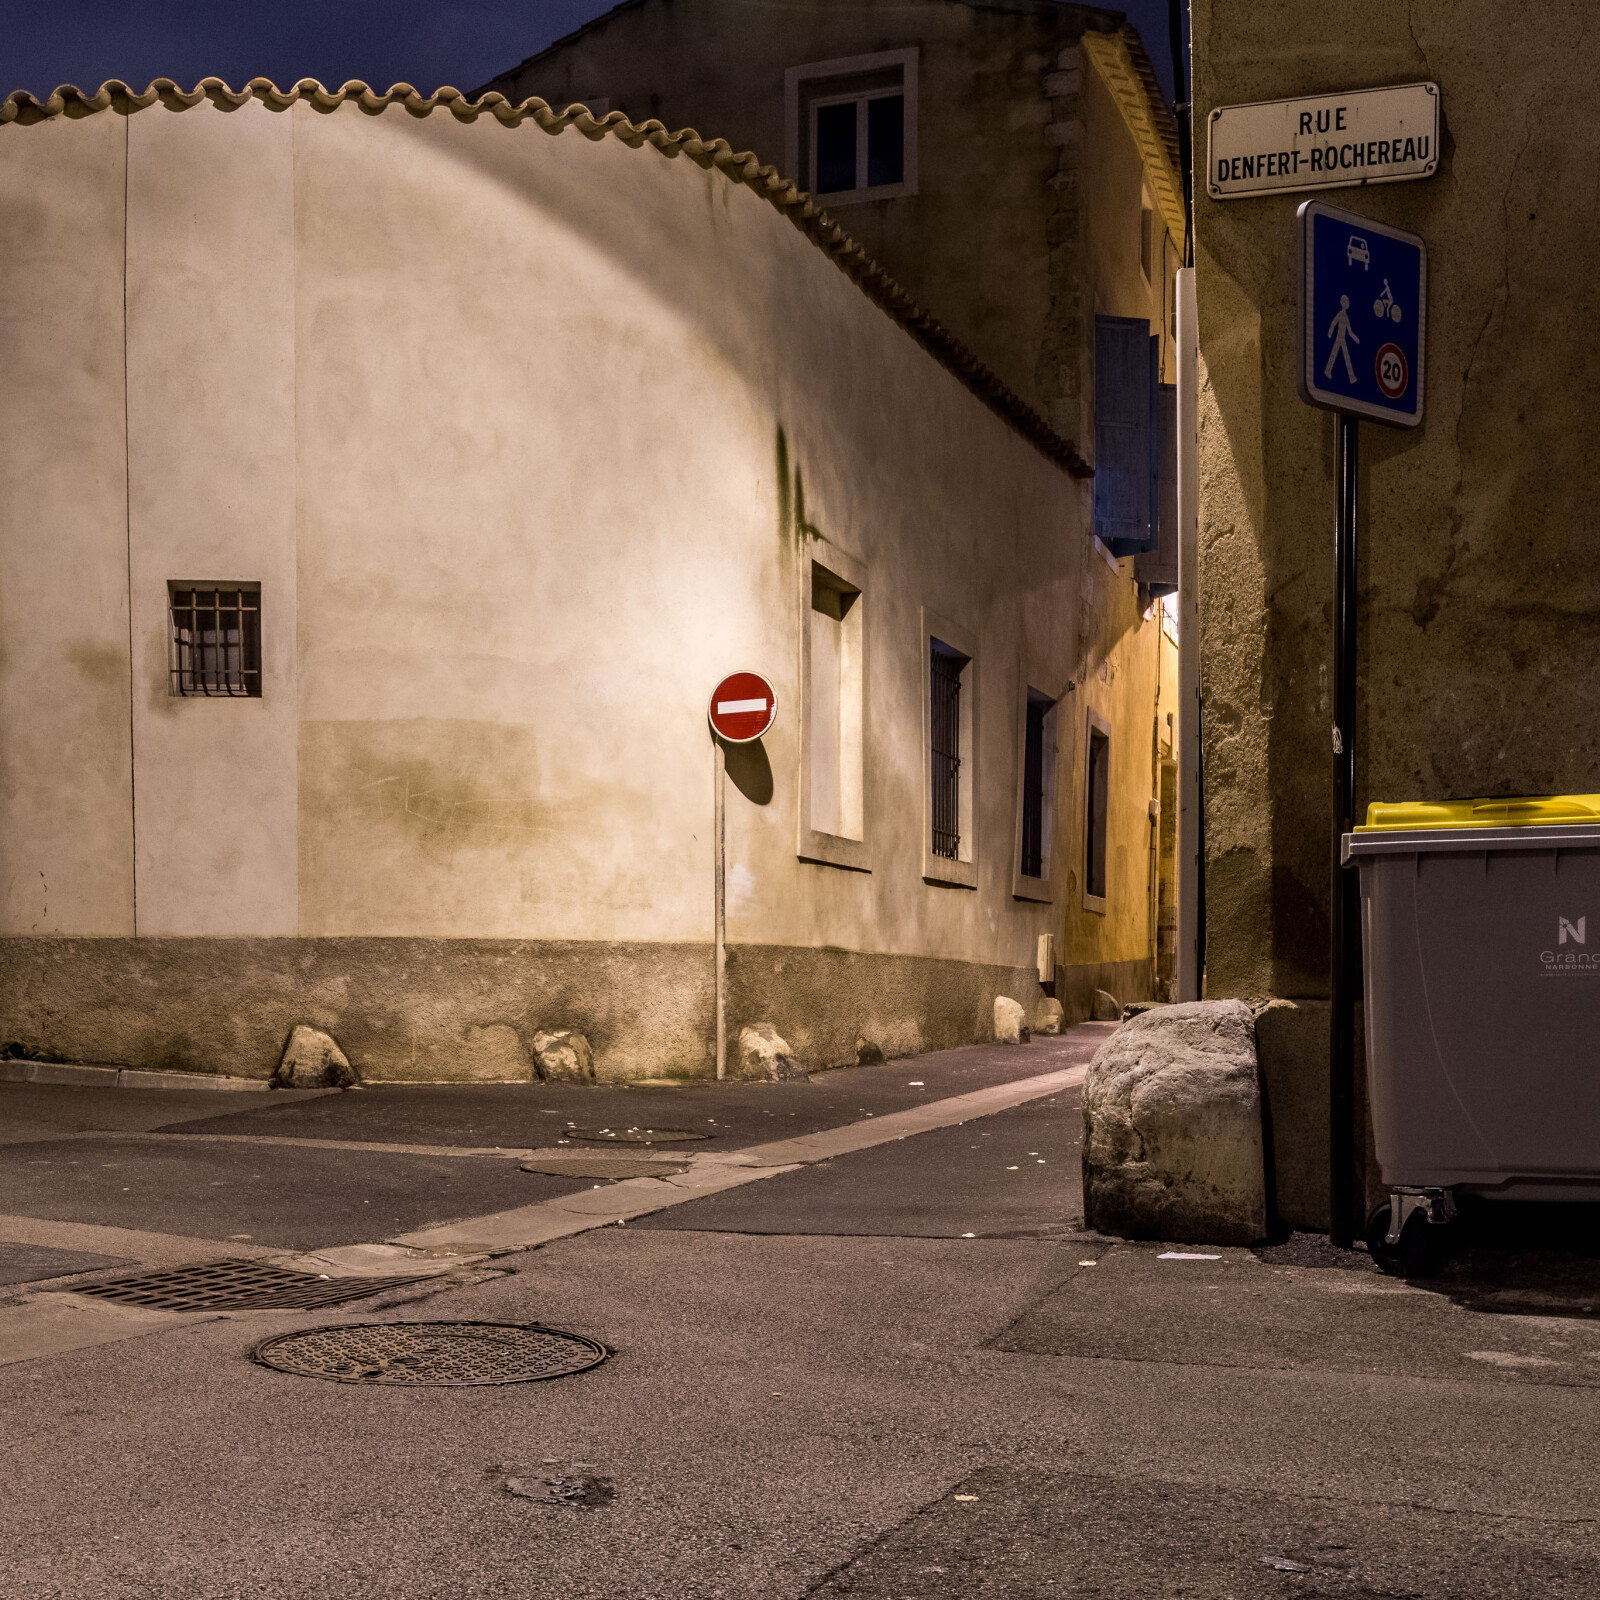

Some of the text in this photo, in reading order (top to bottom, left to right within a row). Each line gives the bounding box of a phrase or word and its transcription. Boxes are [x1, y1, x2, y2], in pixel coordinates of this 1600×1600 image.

[1299, 106, 1348, 136] RUE
[1217, 135, 1430, 182] DENFERT-ROCHEREAU
[1383, 360, 1400, 381] 20
[1559, 915, 1585, 945] N
